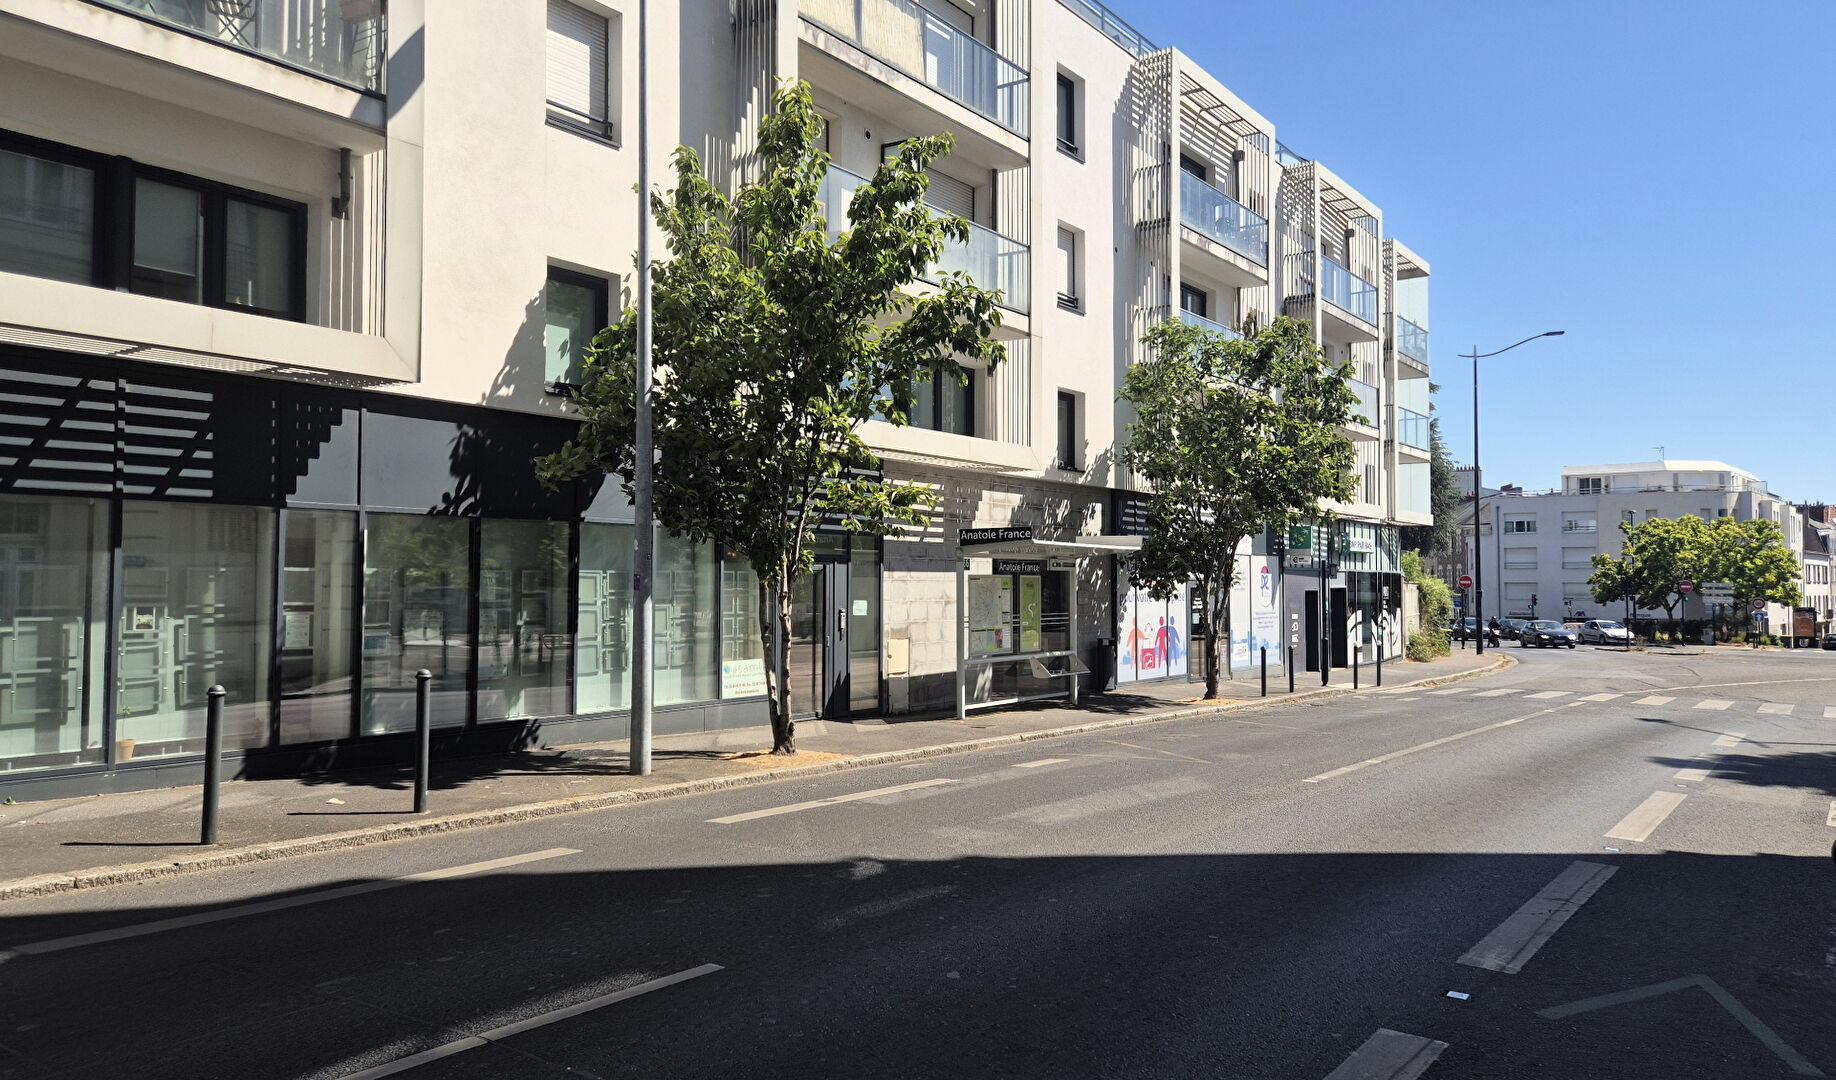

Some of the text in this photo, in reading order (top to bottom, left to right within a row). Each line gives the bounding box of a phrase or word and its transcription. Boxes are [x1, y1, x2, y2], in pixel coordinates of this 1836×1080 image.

[961, 529, 1031, 540] Anatole France
[999, 562, 1040, 572] Anatole France
